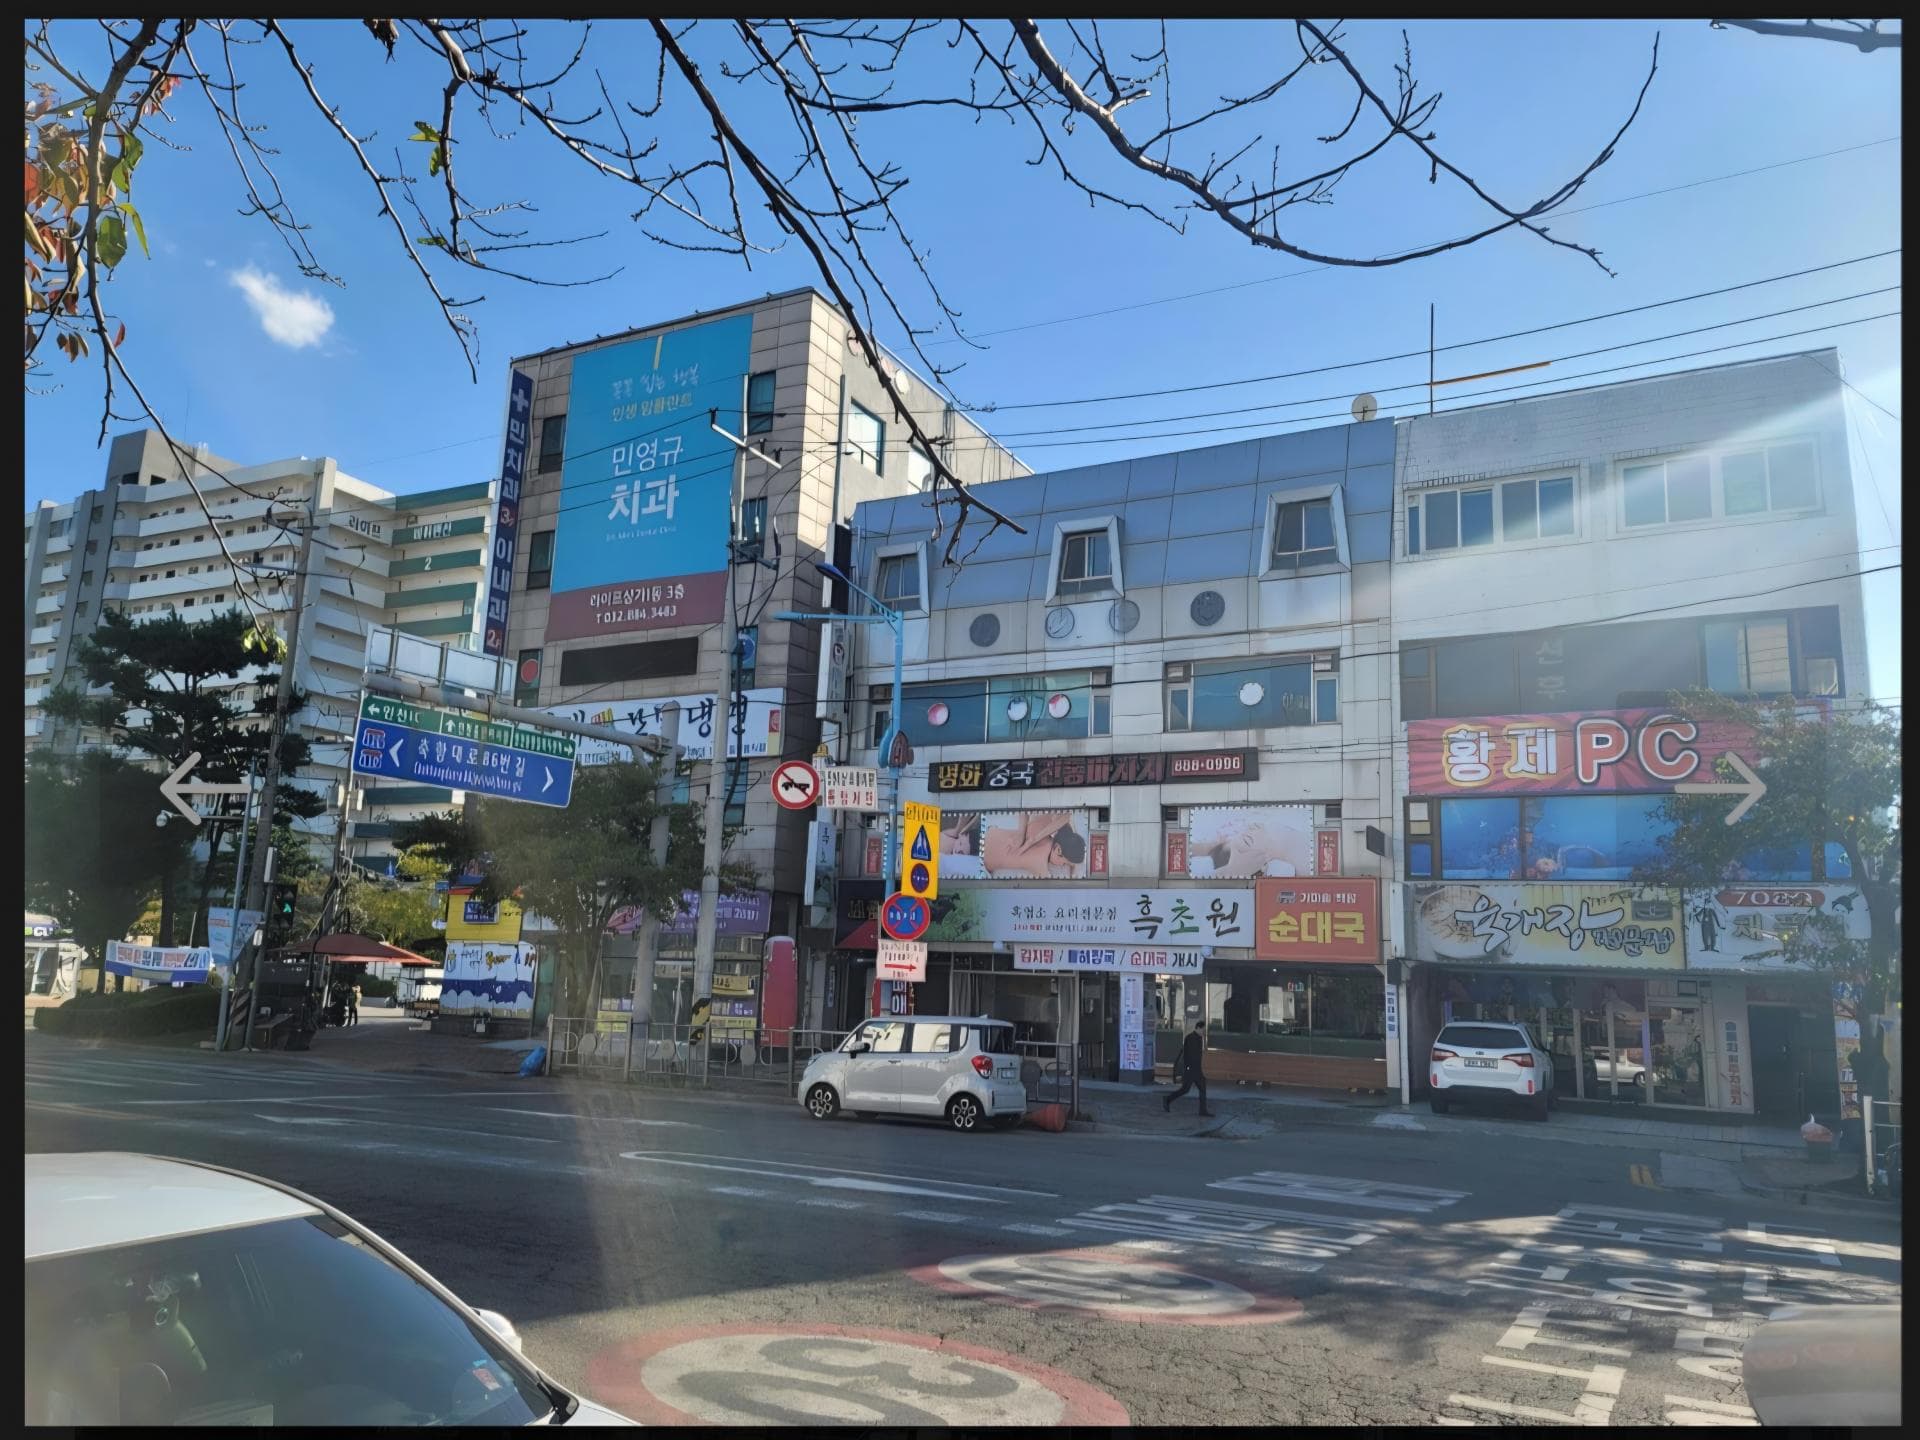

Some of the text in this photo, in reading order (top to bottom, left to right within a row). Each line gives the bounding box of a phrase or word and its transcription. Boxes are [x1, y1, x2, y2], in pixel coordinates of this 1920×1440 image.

[612, 436, 684, 477] 민영규
[607, 474, 680, 525] 치과
[424, 556, 433, 571] 2
[1442, 714, 1700, 784] 황제 PC
[1268, 911, 1366, 944] 순대국
[676, 1335, 1018, 1426] 30
